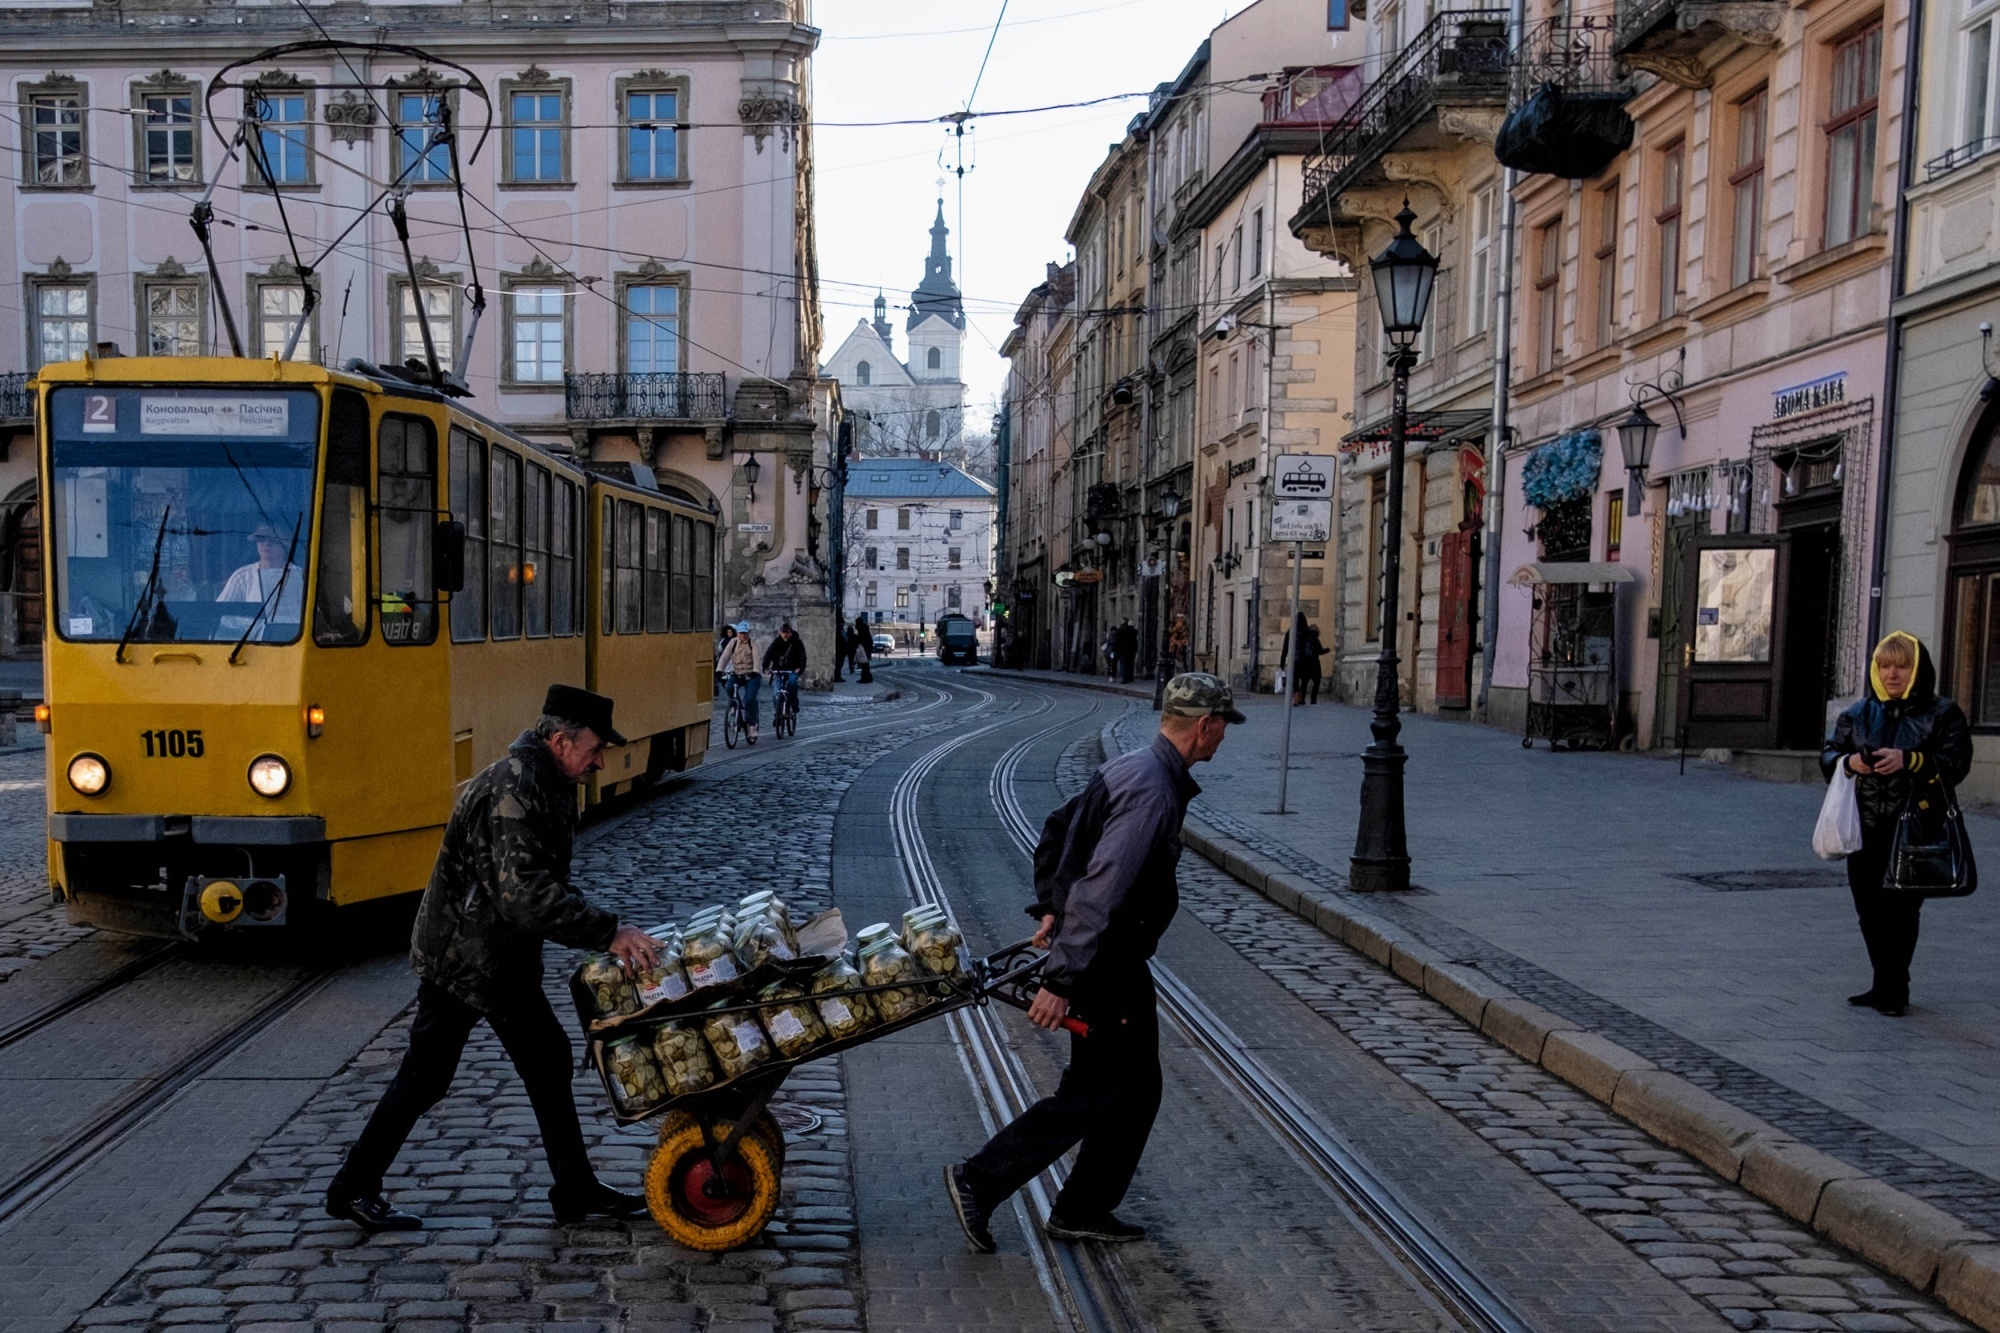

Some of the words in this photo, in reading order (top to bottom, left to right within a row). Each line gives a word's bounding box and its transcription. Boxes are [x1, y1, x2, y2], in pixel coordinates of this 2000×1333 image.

[90, 396, 109, 420] 2
[146, 403, 214, 416] Коновальця
[239, 403, 283, 414] Пасічна
[1773, 388, 1810, 419] AROMA
[1813, 378, 1844, 408] KAVA
[382, 619, 412, 640] ДЕП
[141, 729, 205, 758] 1105
